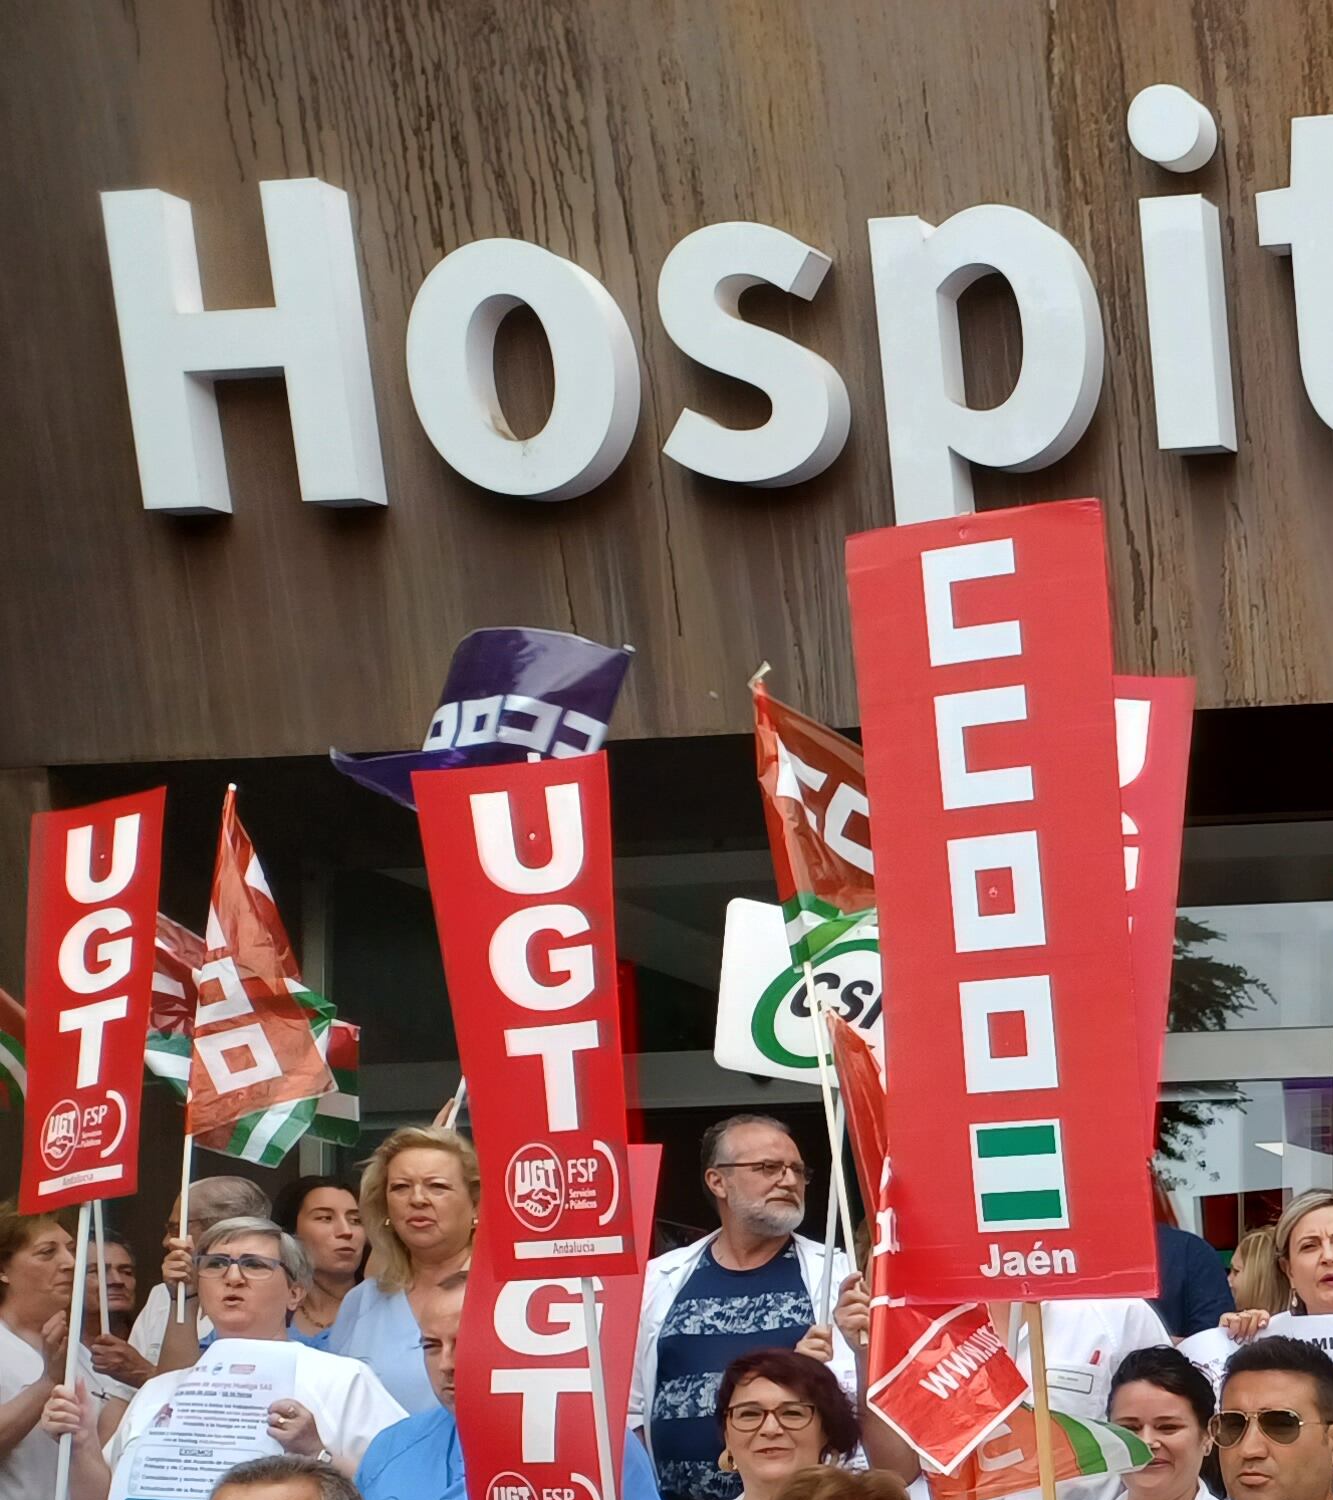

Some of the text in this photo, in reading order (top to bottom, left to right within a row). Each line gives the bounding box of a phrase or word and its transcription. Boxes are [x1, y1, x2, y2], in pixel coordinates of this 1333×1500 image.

[920, 537, 1059, 1094] CCOO
[58, 812, 141, 1089] UGT
[469, 782, 600, 1134] UGT
[82, 1104, 108, 1128] FSP
[567, 1158, 598, 1184] FSP
[515, 1159, 557, 1196] UGT
[979, 1240, 1078, 1278] Jaén
[490, 1276, 604, 1463] GT
